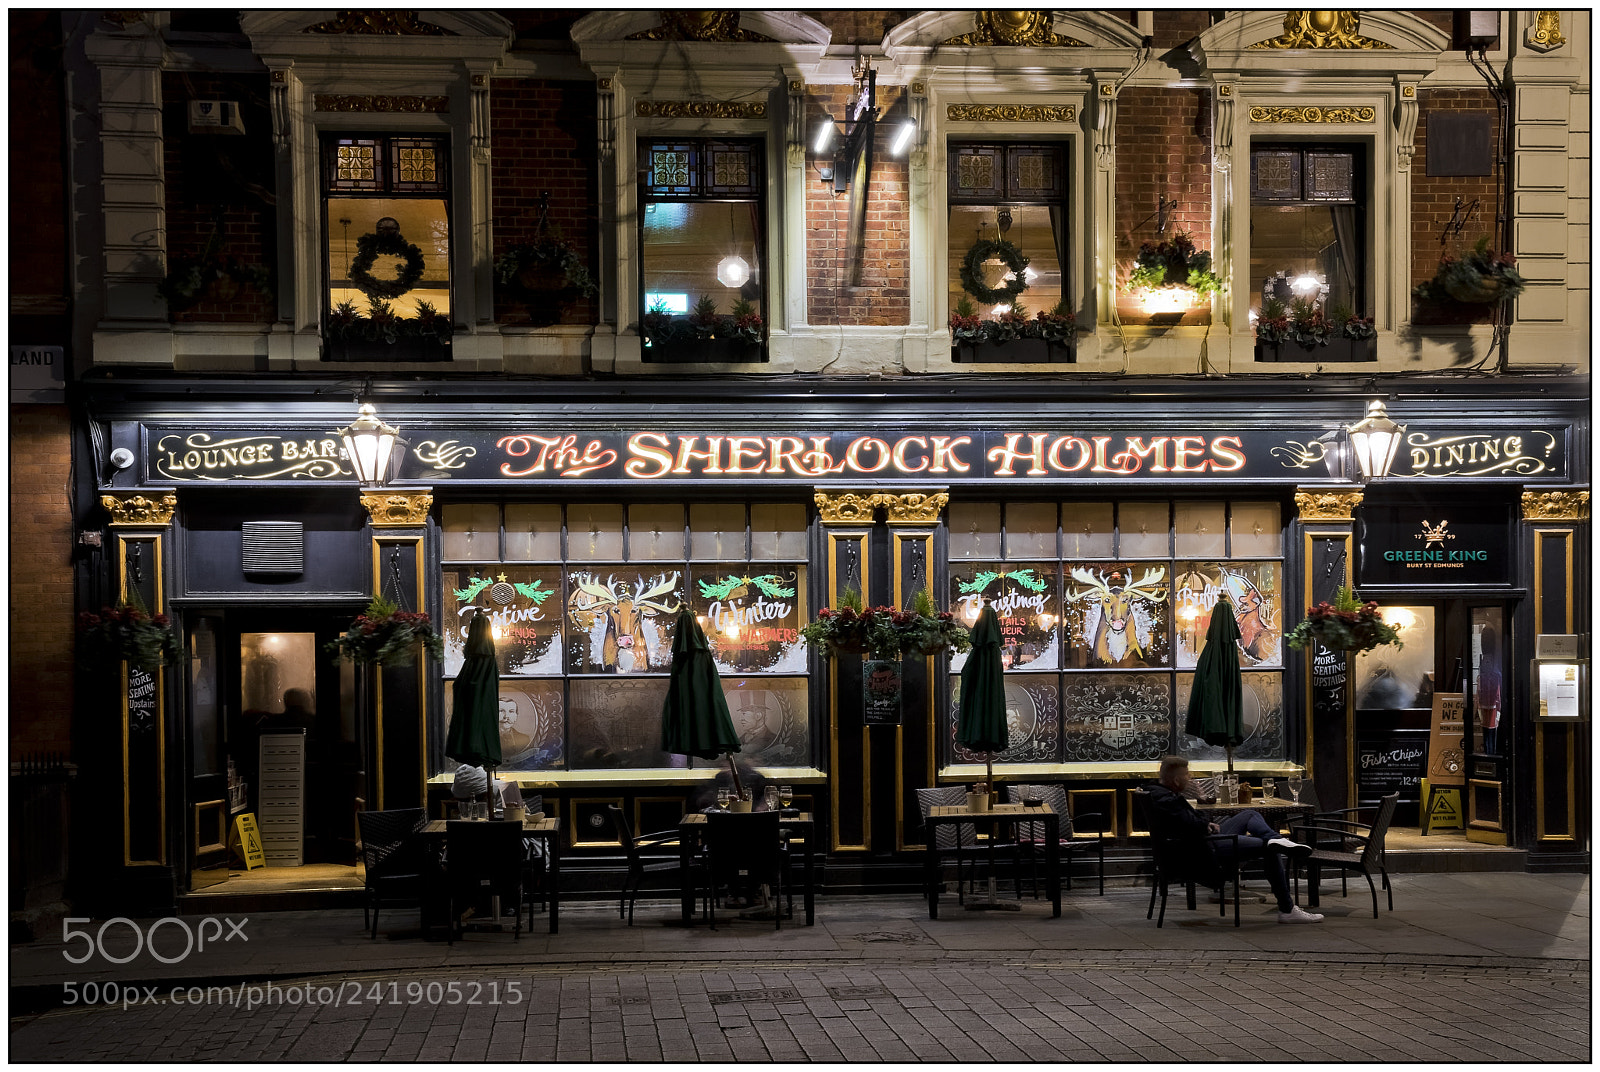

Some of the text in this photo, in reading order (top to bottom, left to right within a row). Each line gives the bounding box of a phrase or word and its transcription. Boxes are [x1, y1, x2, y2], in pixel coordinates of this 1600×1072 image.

[168, 439, 338, 470] LOUNGE BAR
[496, 431, 1247, 478] The SHERLOCK HOLMES
[1410, 436, 1522, 469] DINING
[1383, 550, 1488, 561] GREENE KING
[708, 595, 792, 631] Winter
[501, 627, 537, 639] MENUS
[739, 627, 798, 643] WARMERS
[1313, 654, 1337, 666] MORE
[1313, 661, 1346, 676] SEATING
[129, 673, 152, 688] MORE
[1313, 673, 1347, 687] UPSTAIRS
[128, 682, 156, 699] SEATING
[1442, 709, 1458, 720] WE
[1361, 748, 1423, 769] Fish Chips
